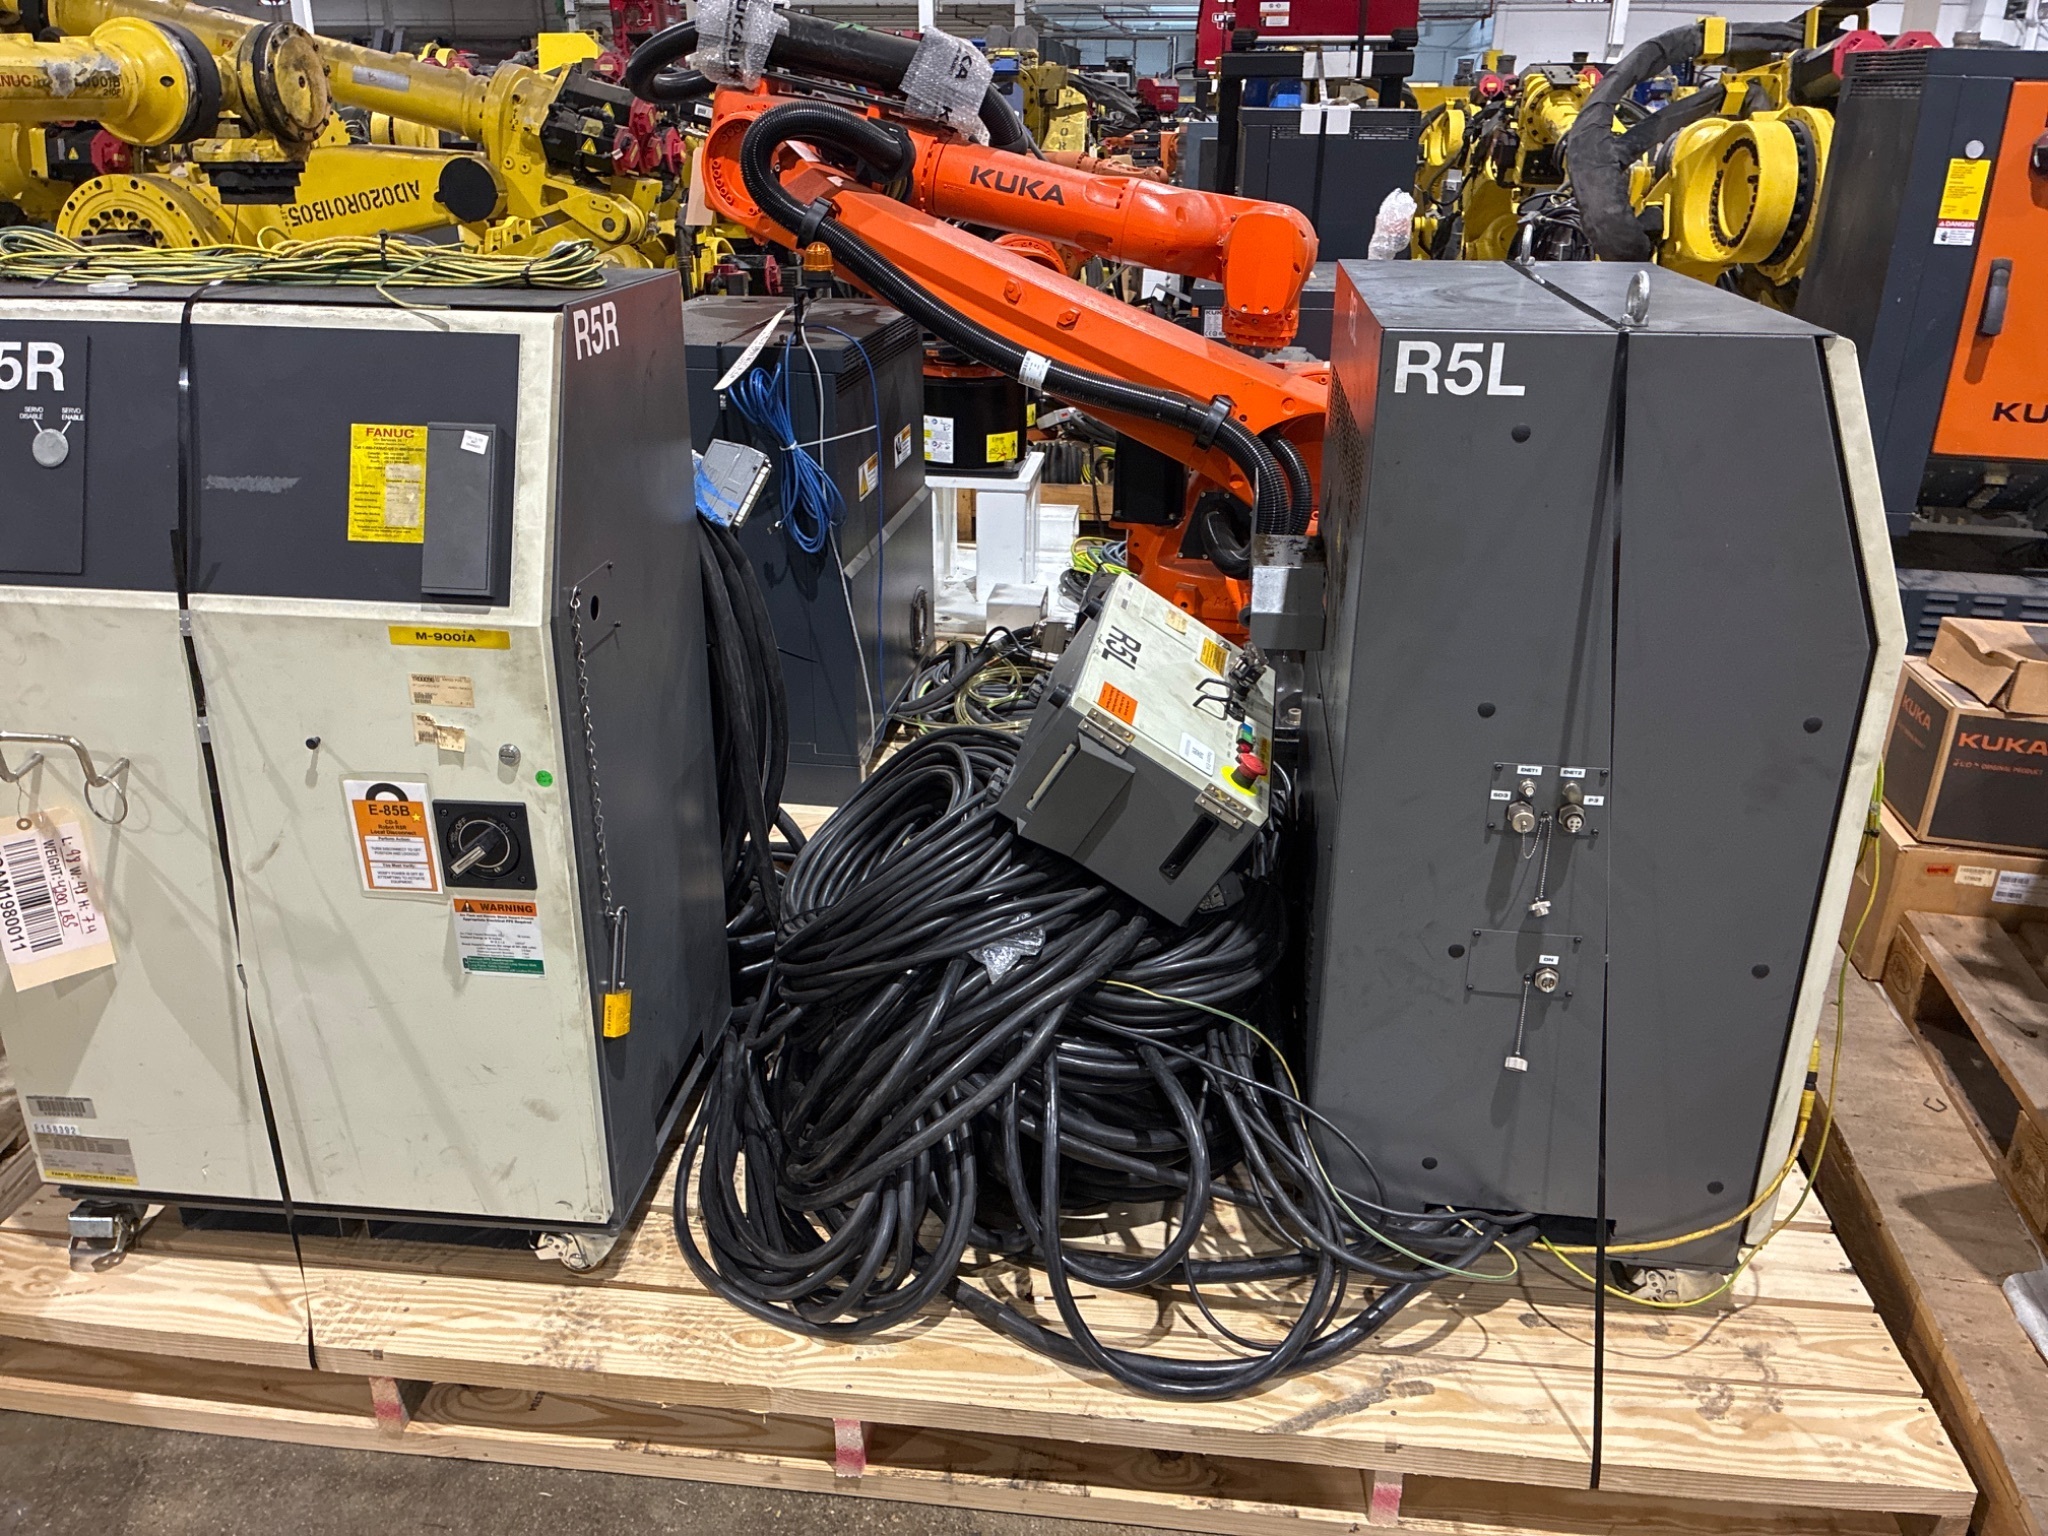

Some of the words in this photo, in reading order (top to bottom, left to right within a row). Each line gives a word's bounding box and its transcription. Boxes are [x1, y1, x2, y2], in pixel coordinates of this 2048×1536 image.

[0, 74, 32, 88] NUC
[969, 165, 1066, 207] KUKA
[572, 301, 620, 361] R5R
[1393, 340, 1526, 396] R5L
[366, 427, 415, 439] FANUC
[415, 630, 476, 643] M-900iA
[1101, 625, 1142, 670] R5L
[1901, 694, 1932, 732] KUKA
[1958, 732, 2048, 757] KUKA
[368, 803, 410, 817] E-85B
[454, 817, 467, 831] OFF
[500, 822, 511, 834] ON
[43, 839, 63, 881] WEIGHT:
[480, 902, 533, 913] WARNING
